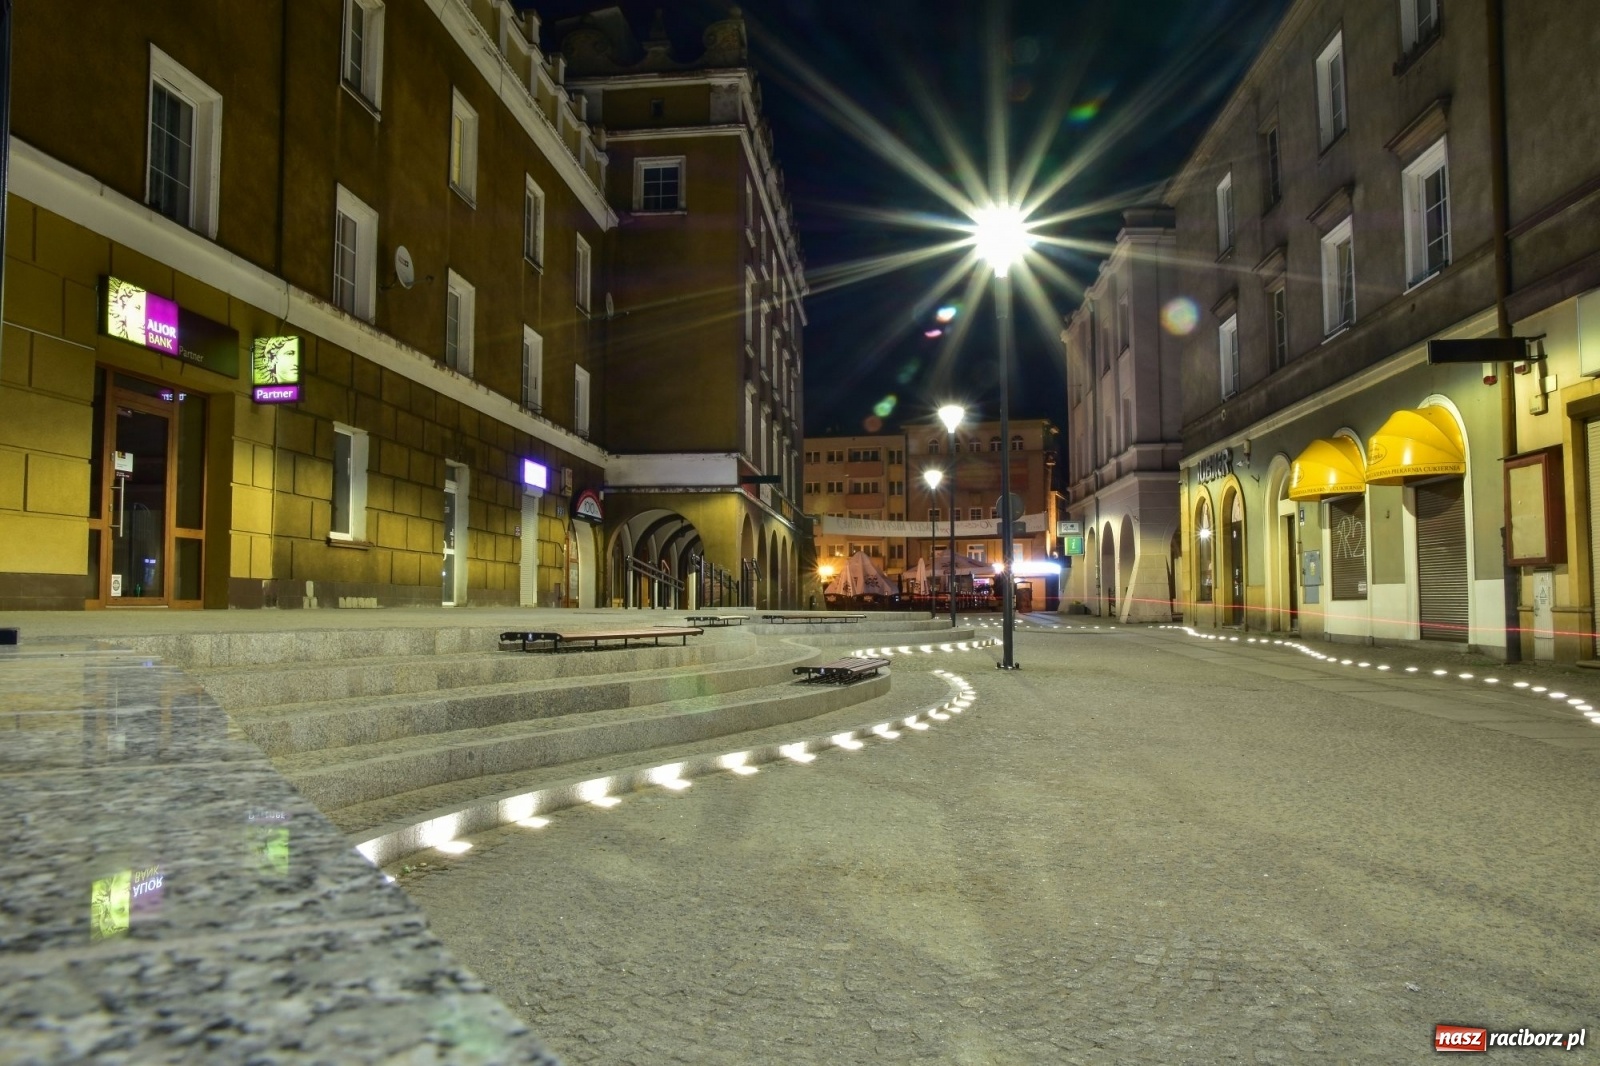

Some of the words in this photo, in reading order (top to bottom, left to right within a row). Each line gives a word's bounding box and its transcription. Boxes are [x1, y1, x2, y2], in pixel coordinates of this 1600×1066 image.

[147, 318, 177, 339] ALIOR
[148, 333, 173, 350] BANK
[178, 345, 204, 363] Partner
[256, 387, 294, 400] Partner
[1423, 465, 1461, 473] CUKIERNIA
